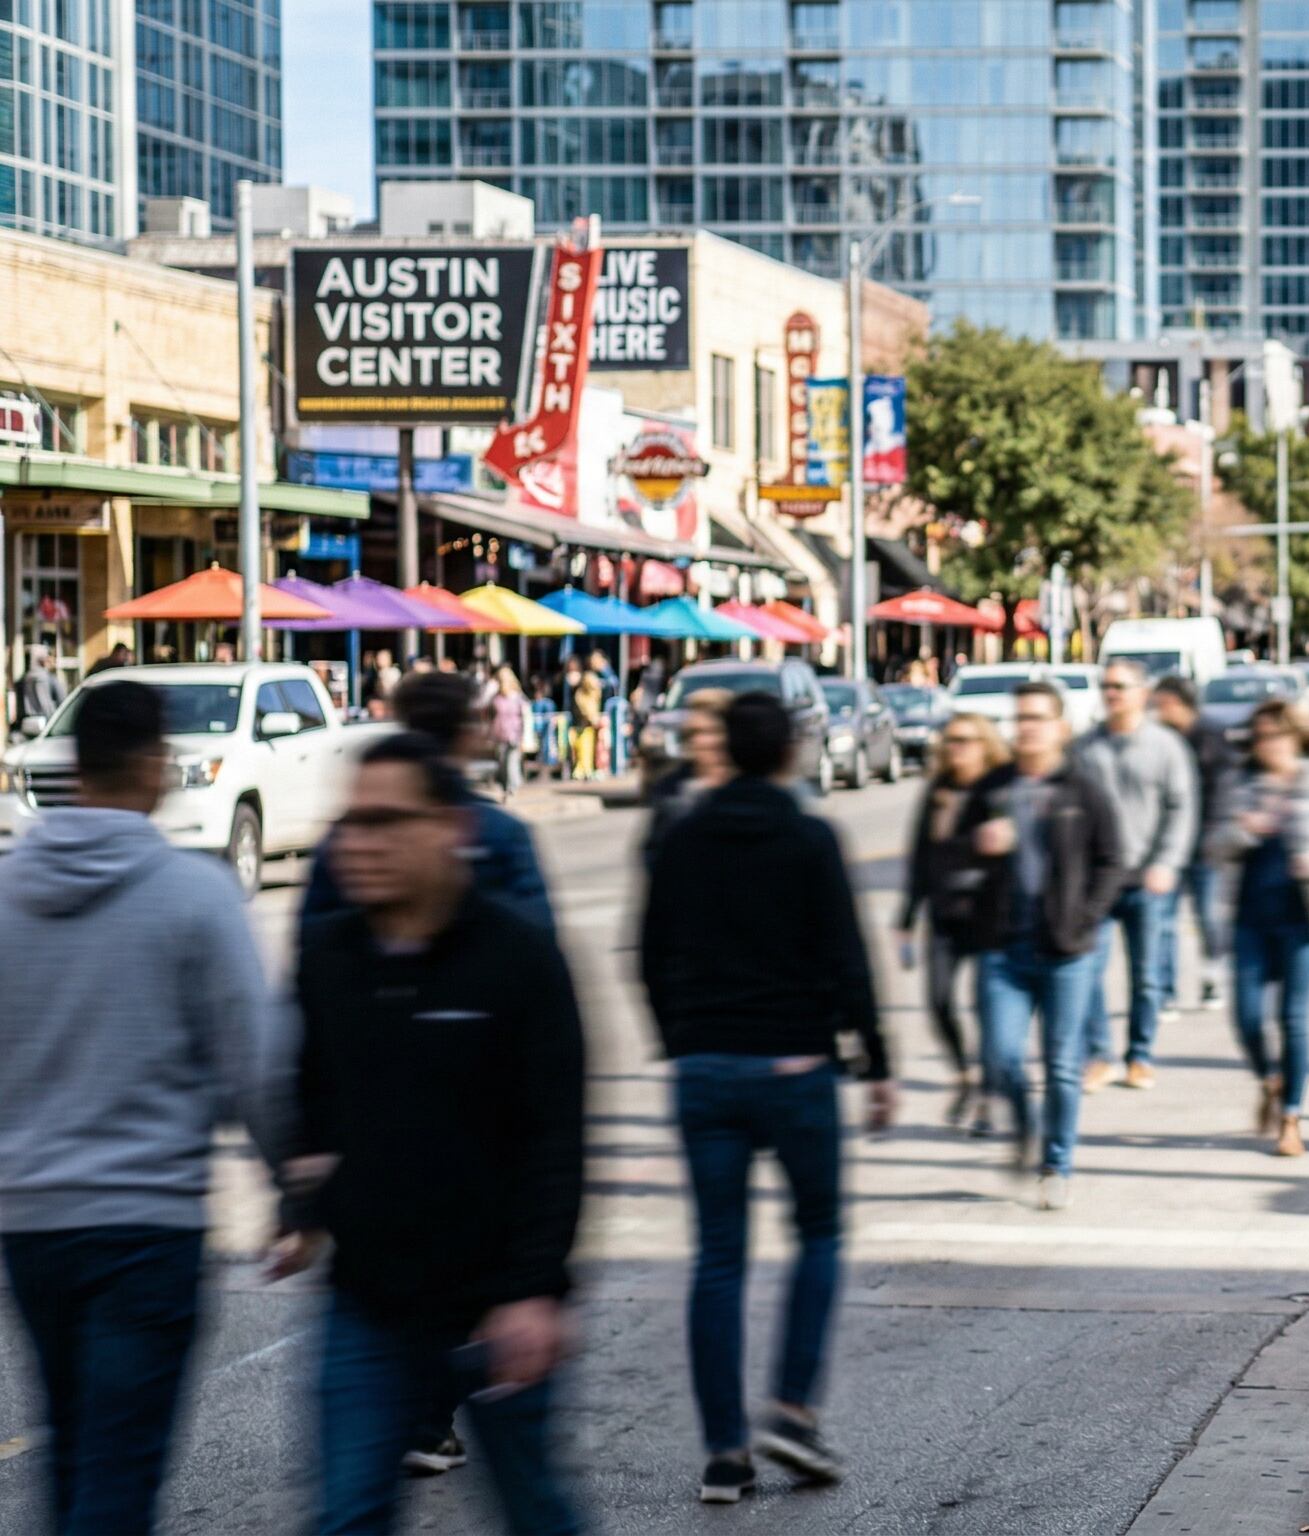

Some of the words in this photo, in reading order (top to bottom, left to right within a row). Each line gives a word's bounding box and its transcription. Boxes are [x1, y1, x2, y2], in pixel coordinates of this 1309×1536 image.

[315, 256, 500, 298] AUSTIN
[313, 301, 502, 342] VISITOR
[544, 261, 583, 413] SIXTH
[587, 323, 667, 362] HERE
[316, 346, 502, 387] CENTER
